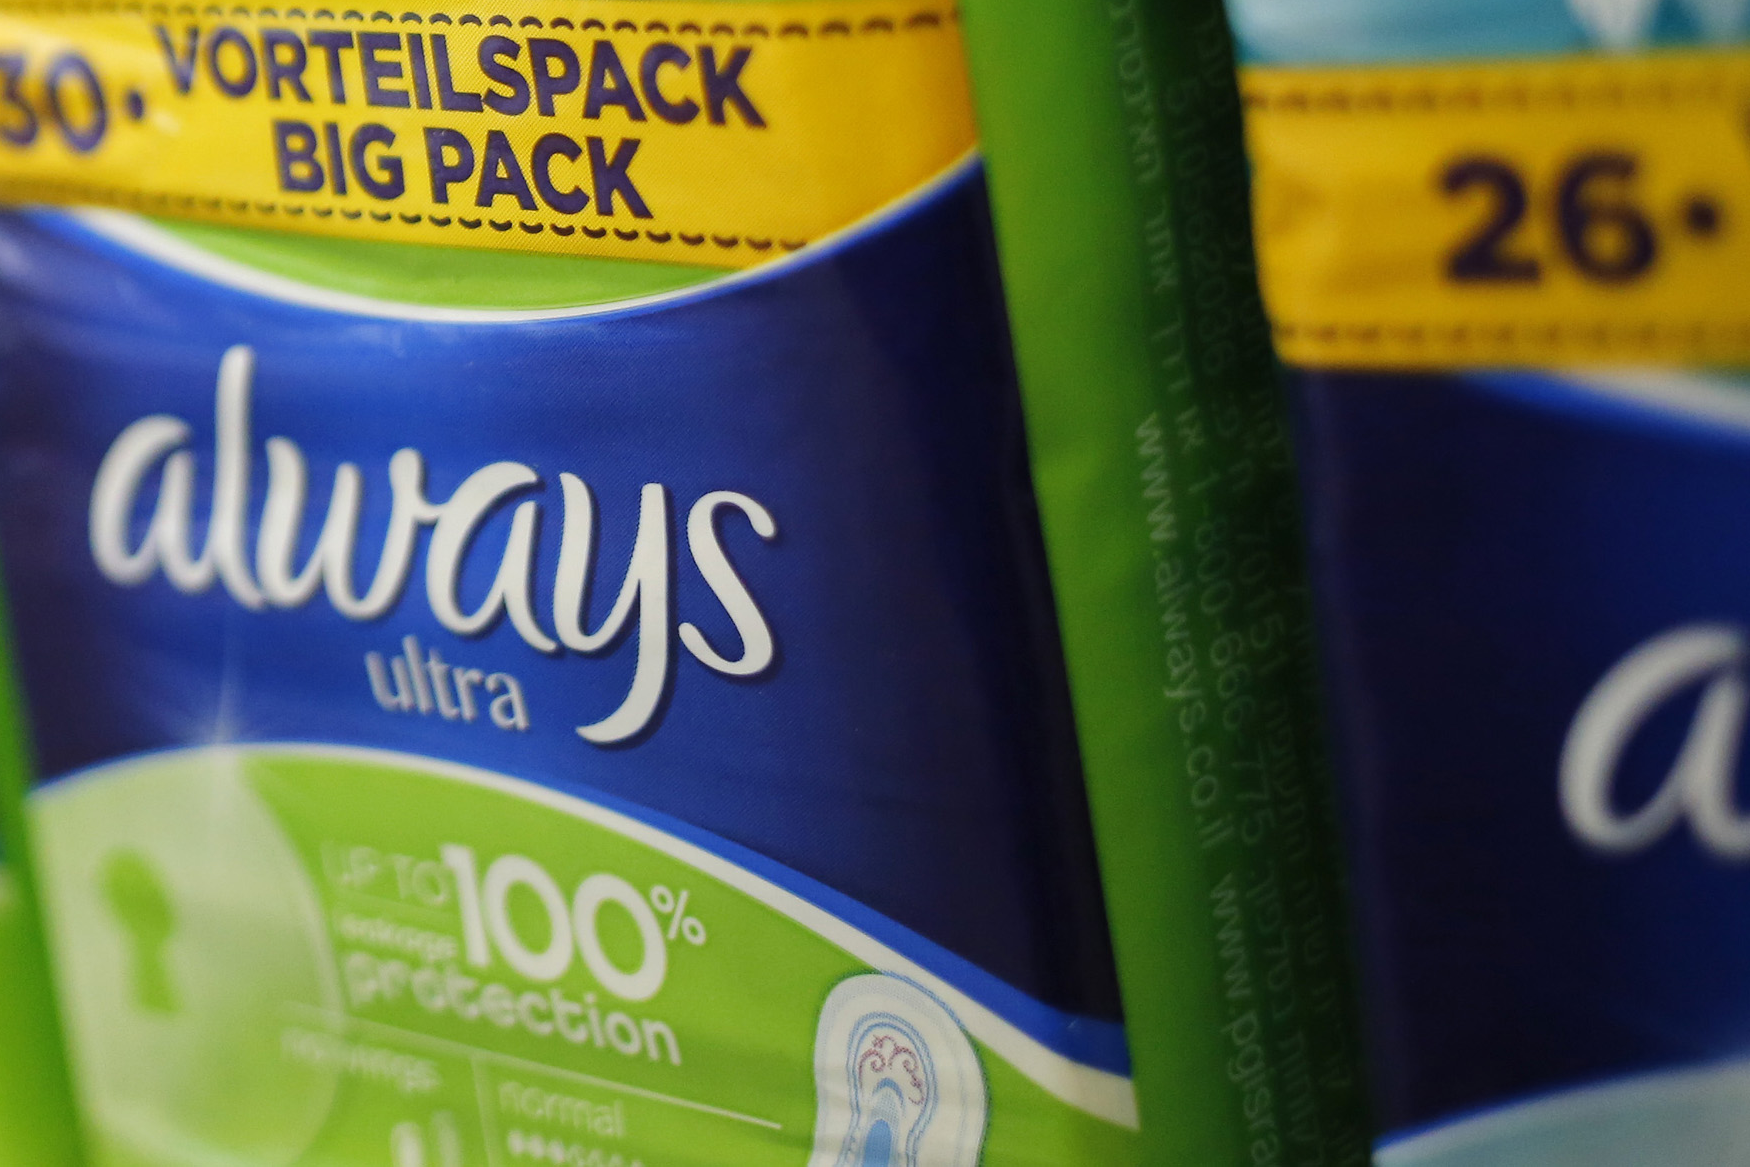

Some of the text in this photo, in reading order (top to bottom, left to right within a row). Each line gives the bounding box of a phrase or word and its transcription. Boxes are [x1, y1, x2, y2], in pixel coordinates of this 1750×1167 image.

[154, 22, 768, 131] VORTEILSPACK
[274, 119, 656, 220] BIG PACK
[88, 343, 780, 745] always
[363, 634, 529, 733] ultra
[345, 949, 681, 1066] protection
